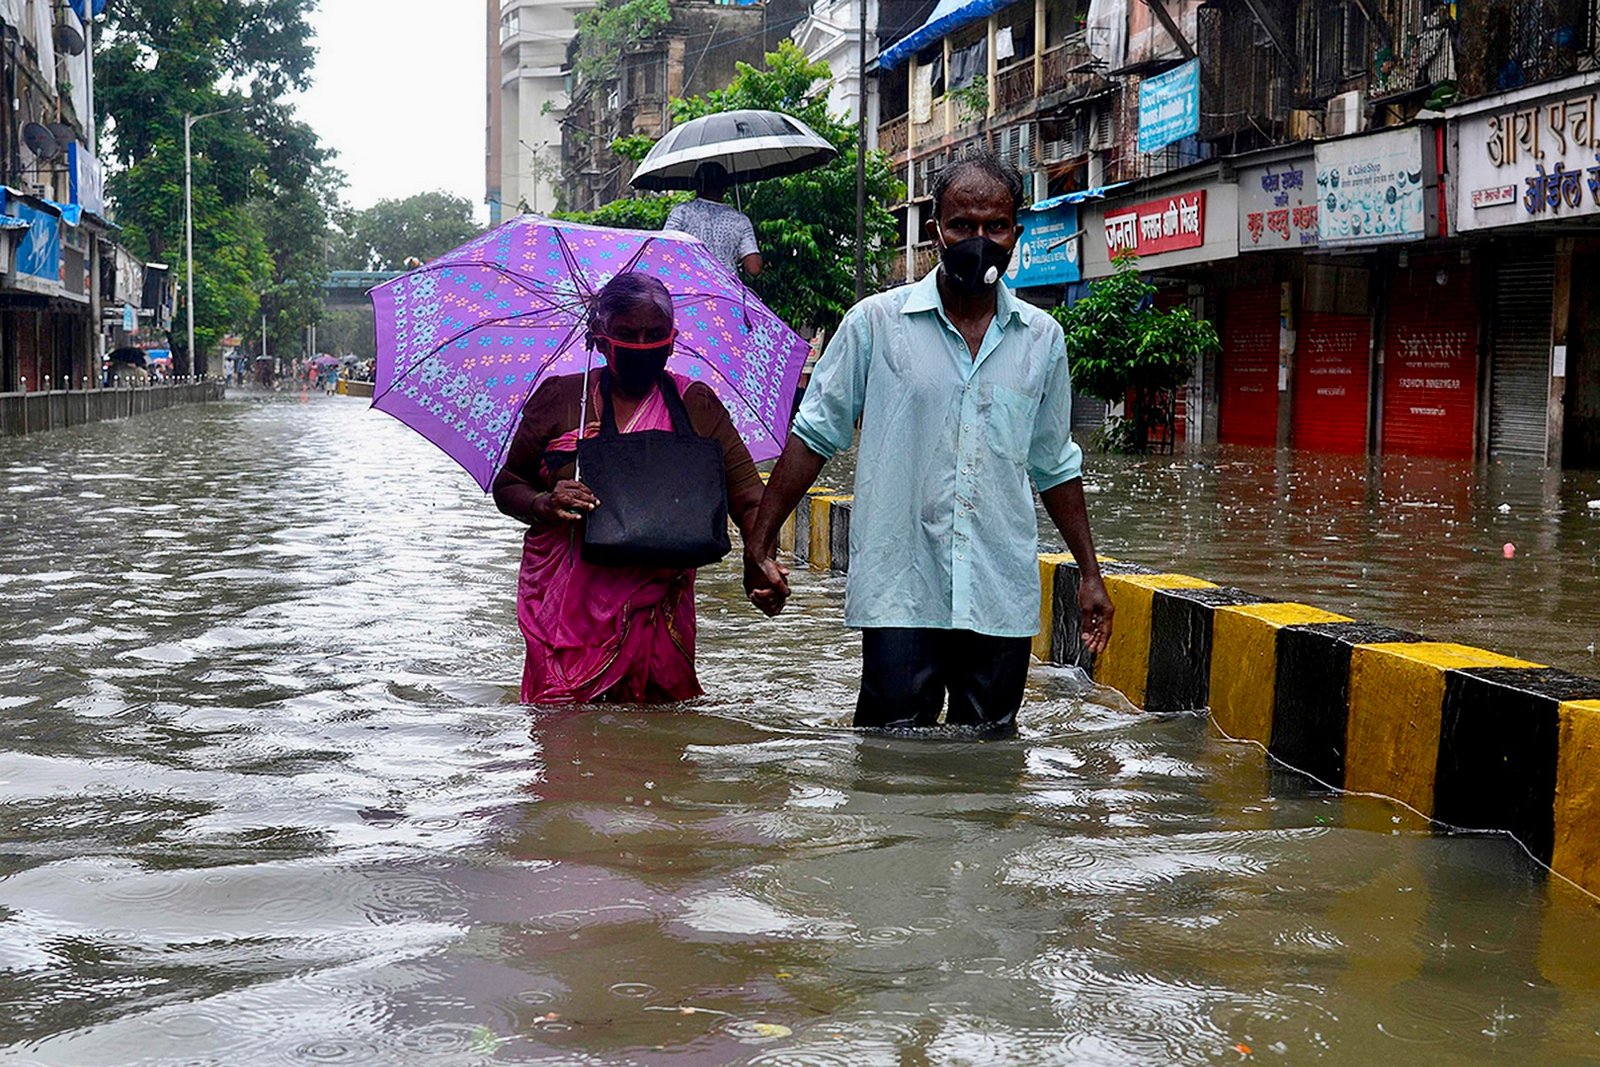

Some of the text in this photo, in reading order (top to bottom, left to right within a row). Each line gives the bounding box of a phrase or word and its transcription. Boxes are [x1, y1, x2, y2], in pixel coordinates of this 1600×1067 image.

[1105, 212, 1138, 252] जनता
[1163, 200, 1179, 237] आणि
[1399, 378, 1461, 389] FASHION INNERWEAR
